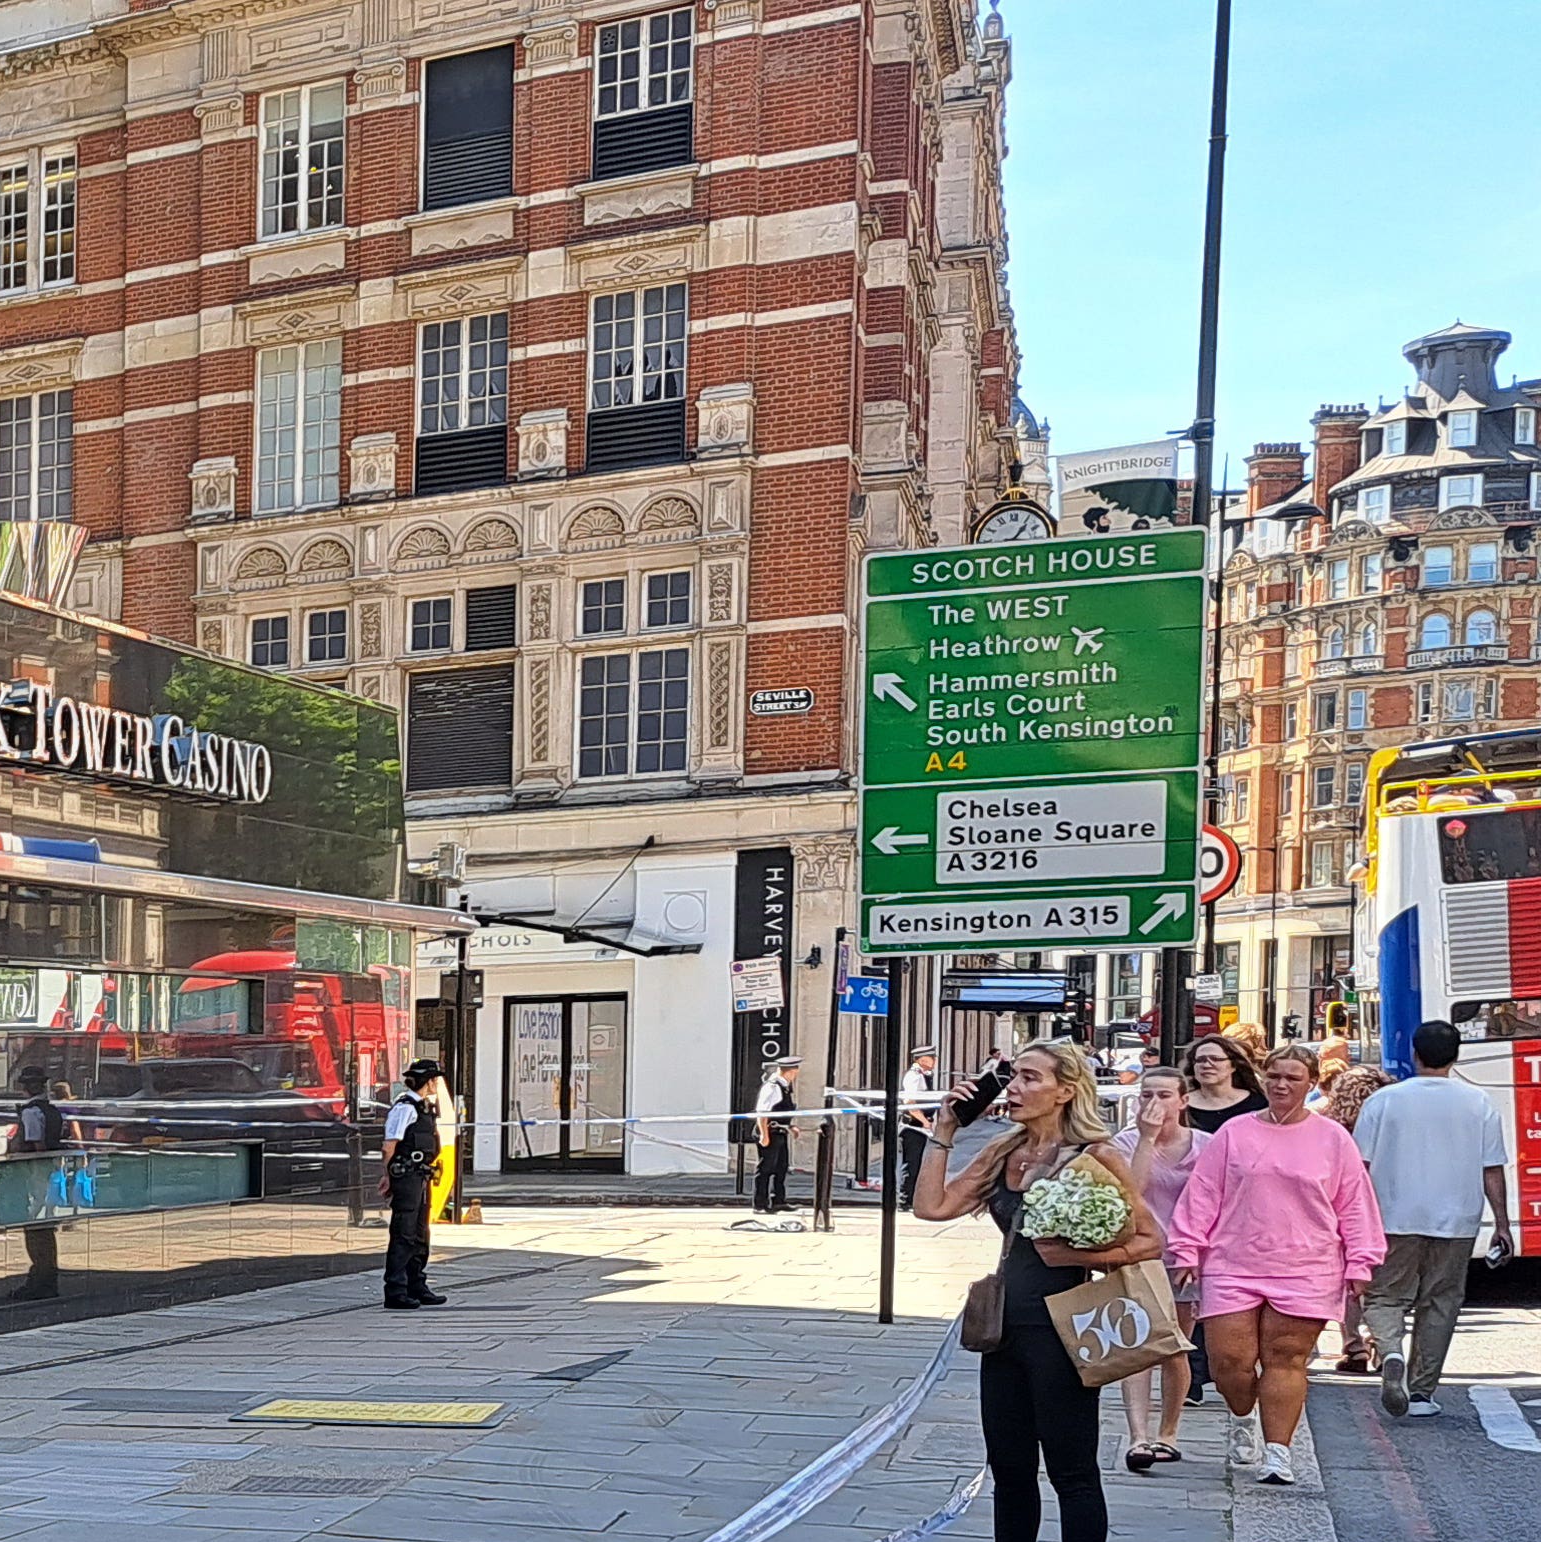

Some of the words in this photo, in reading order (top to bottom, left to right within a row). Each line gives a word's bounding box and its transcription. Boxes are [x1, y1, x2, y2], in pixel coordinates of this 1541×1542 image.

[912, 554, 1035, 583] SCOTCH
[1047, 543, 1157, 573] HOUSE
[928, 603, 977, 625] The
[986, 596, 1068, 621] WEST
[928, 632, 1062, 659] Heathrow
[928, 662, 1117, 693] Hammersmith
[753, 702, 792, 712] STREET
[756, 690, 807, 702] SEVILLE
[927, 696, 996, 721] Earls
[1006, 690, 1086, 717] Court
[28, 683, 154, 781] TOWER
[161, 716, 272, 802] CASINO
[926, 721, 1007, 746] South
[1017, 712, 1174, 741] Kensington
[925, 751, 967, 774] A4
[947, 797, 1058, 819] Chelsea
[947, 824, 1044, 846] Sloane
[1053, 818, 1157, 845] Square
[946, 849, 1038, 872] A3216
[878, 907, 1033, 938] Kensington
[1042, 904, 1120, 928] A315
[444, 934, 532, 950] NCHOLS
